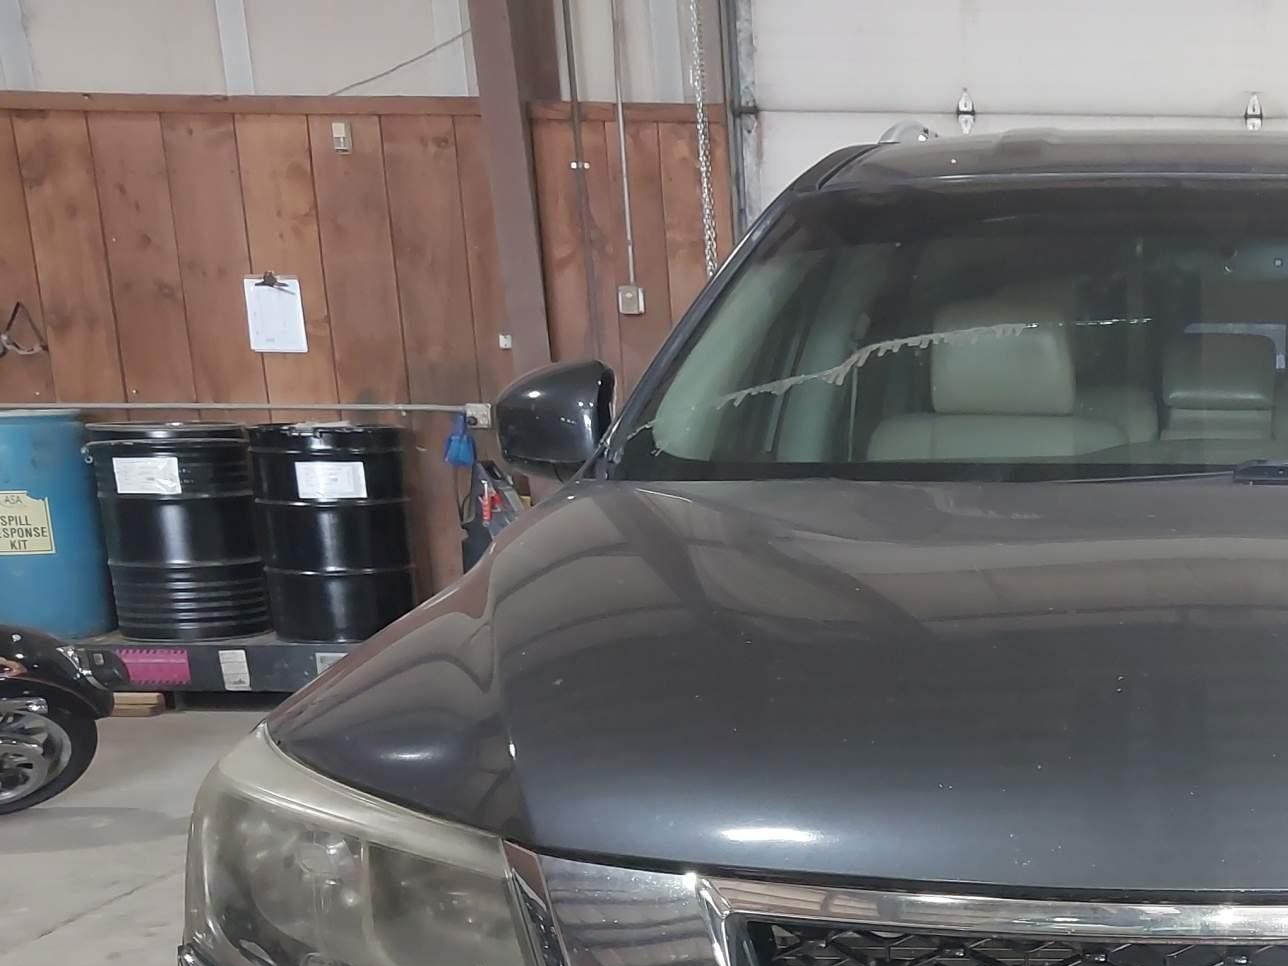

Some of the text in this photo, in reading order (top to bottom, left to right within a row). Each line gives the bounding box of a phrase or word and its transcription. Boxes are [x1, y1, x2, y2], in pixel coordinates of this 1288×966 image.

[0, 515, 32, 526] SPILL
[0, 526, 48, 538] SPONSE
[10, 539, 28, 550] KIT
